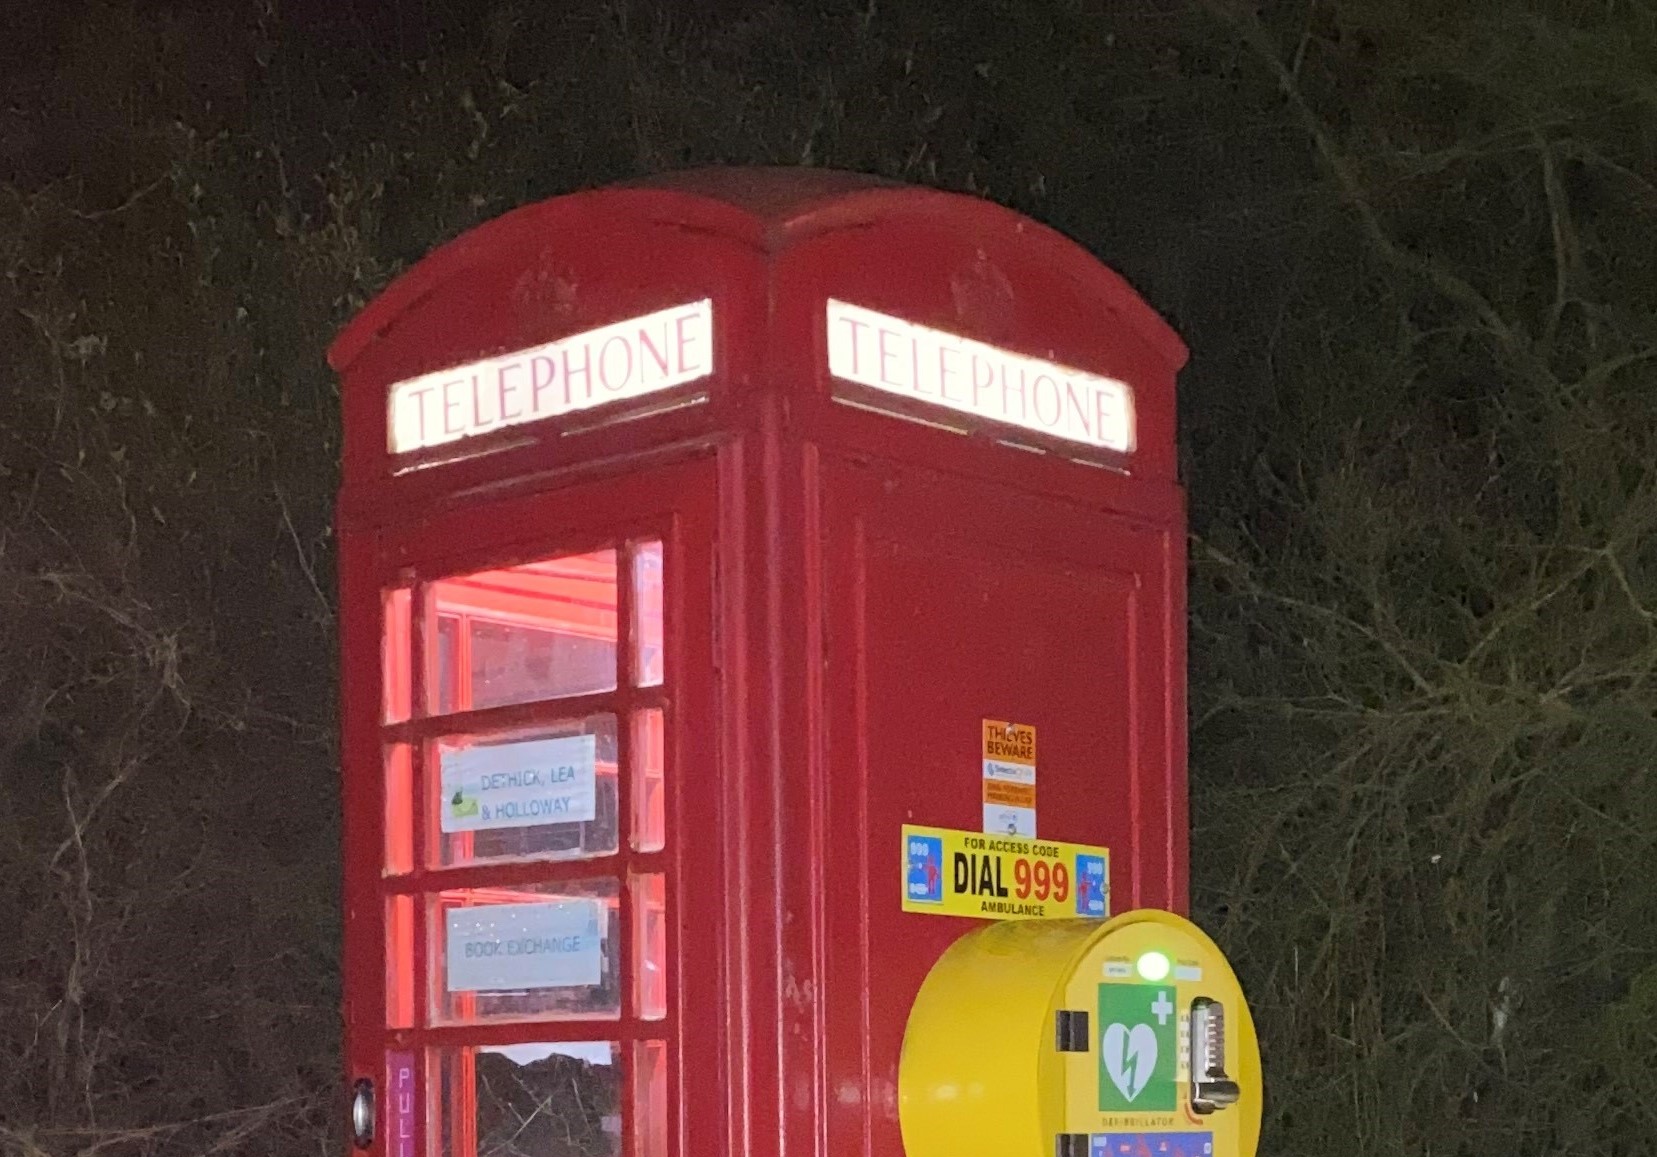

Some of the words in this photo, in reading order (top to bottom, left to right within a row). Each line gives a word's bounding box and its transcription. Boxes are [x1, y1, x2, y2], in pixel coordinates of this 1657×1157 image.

[408, 312, 702, 441] TELEPHONE
[838, 316, 1115, 444] TELEPHONE
[988, 725, 1033, 745] THIEVES
[987, 740, 1033, 760] BEWARE
[551, 766, 576, 783] LEA
[481, 804, 491, 821] &
[495, 796, 572, 819] HOLLOWAY
[964, 837, 986, 850] FOR
[988, 840, 1030, 855] ACCESS
[1032, 845, 1060, 859] CODE
[953, 851, 1009, 898] DIAL
[1014, 858, 1070, 904] 999
[980, 900, 1045, 917] AMBULANCE
[464, 940, 504, 959] BOOK
[507, 935, 581, 957] EXCHANGE
